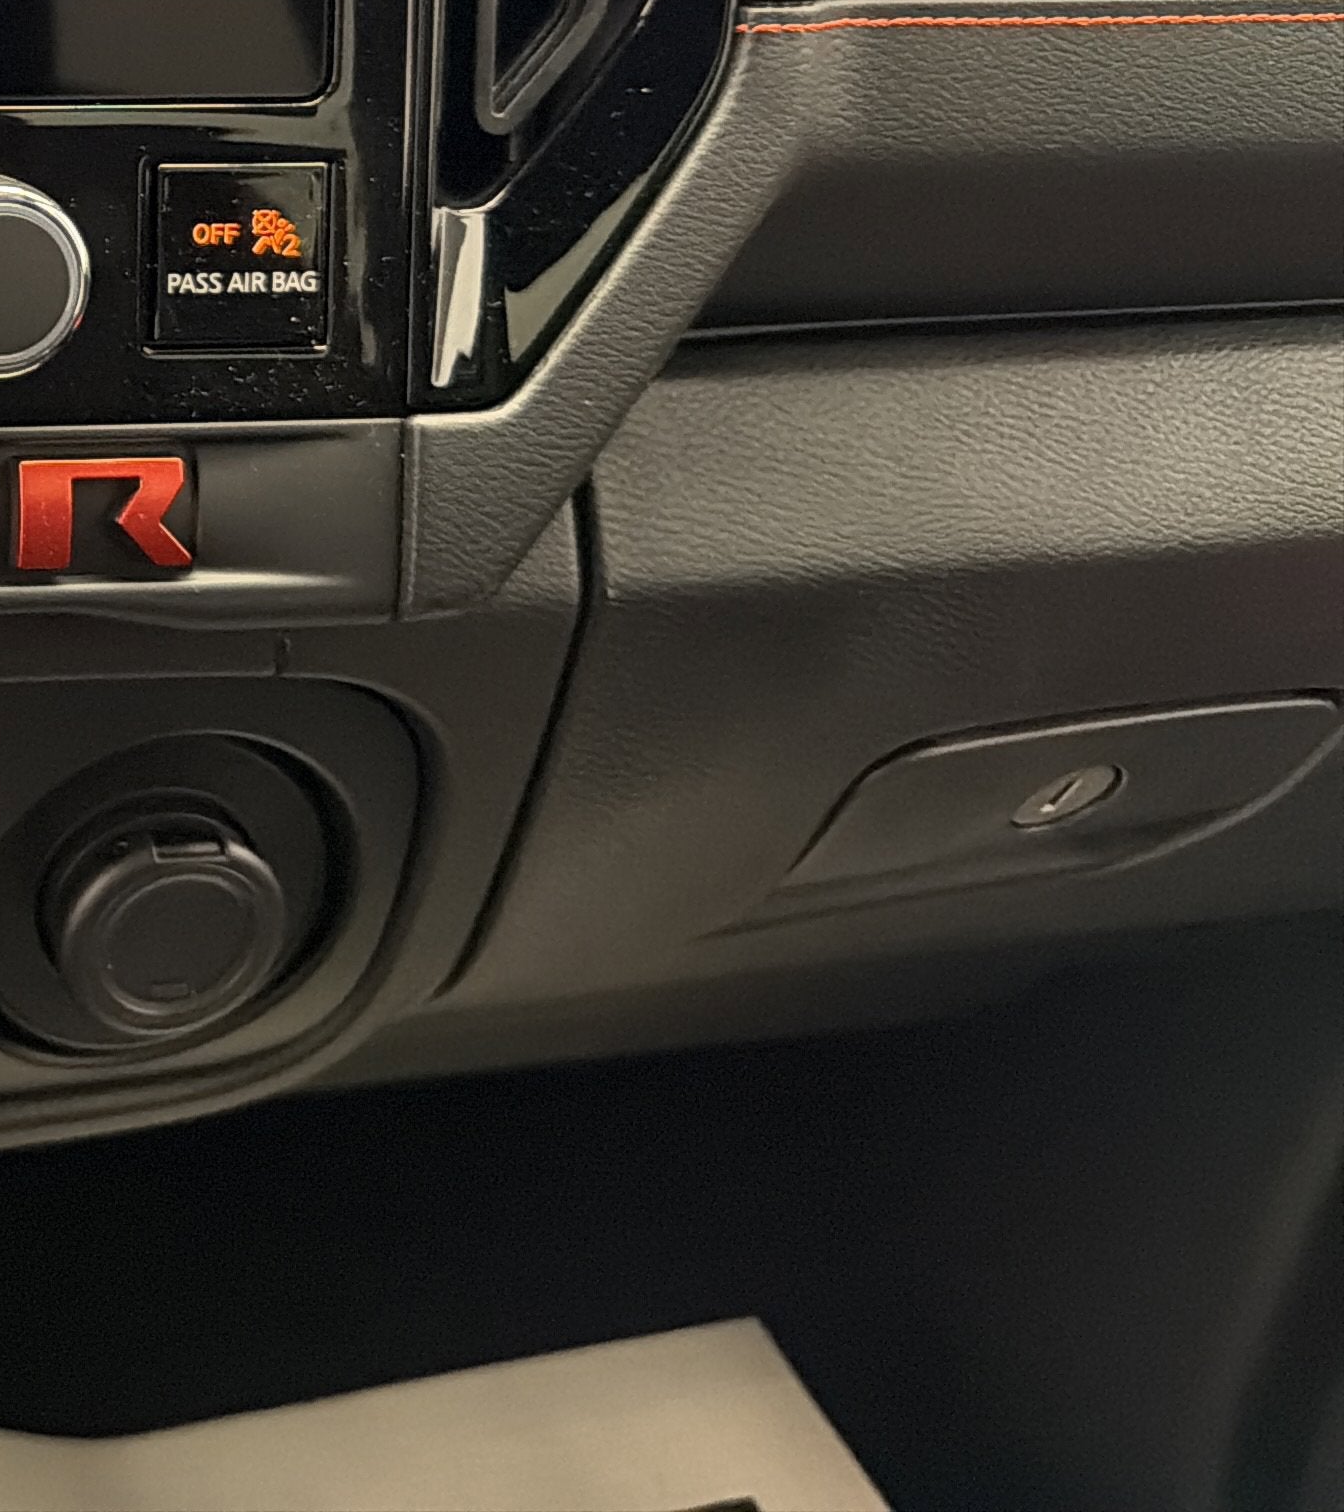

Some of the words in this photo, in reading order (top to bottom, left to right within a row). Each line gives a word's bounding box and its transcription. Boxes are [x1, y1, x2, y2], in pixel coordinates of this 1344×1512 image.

[192, 223, 241, 246] OFF
[167, 273, 222, 295] PASS
[228, 271, 266, 293] AIR
[272, 270, 319, 293] BAG
